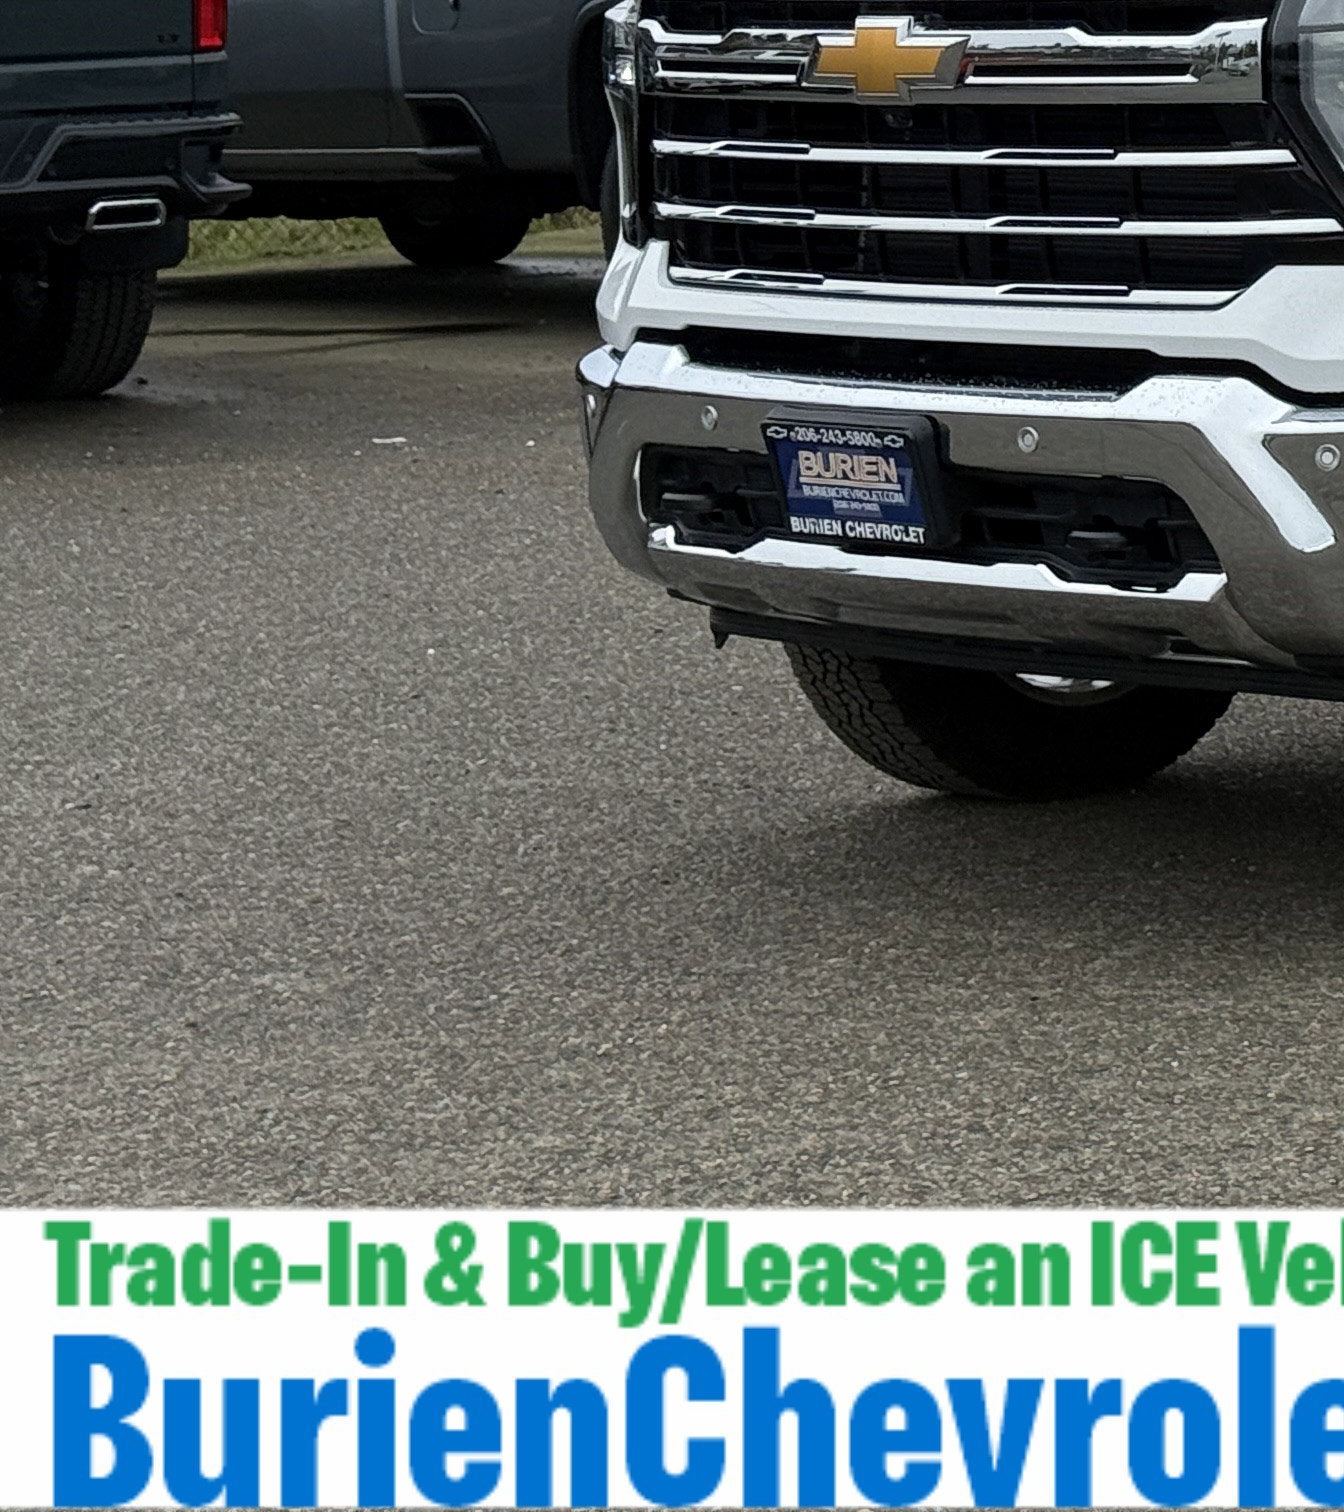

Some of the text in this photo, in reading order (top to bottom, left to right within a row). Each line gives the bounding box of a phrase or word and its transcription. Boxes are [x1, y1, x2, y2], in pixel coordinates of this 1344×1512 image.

[798, 450, 898, 484] BURIEN
[790, 516, 925, 544] BURIEN CHEVROLET
